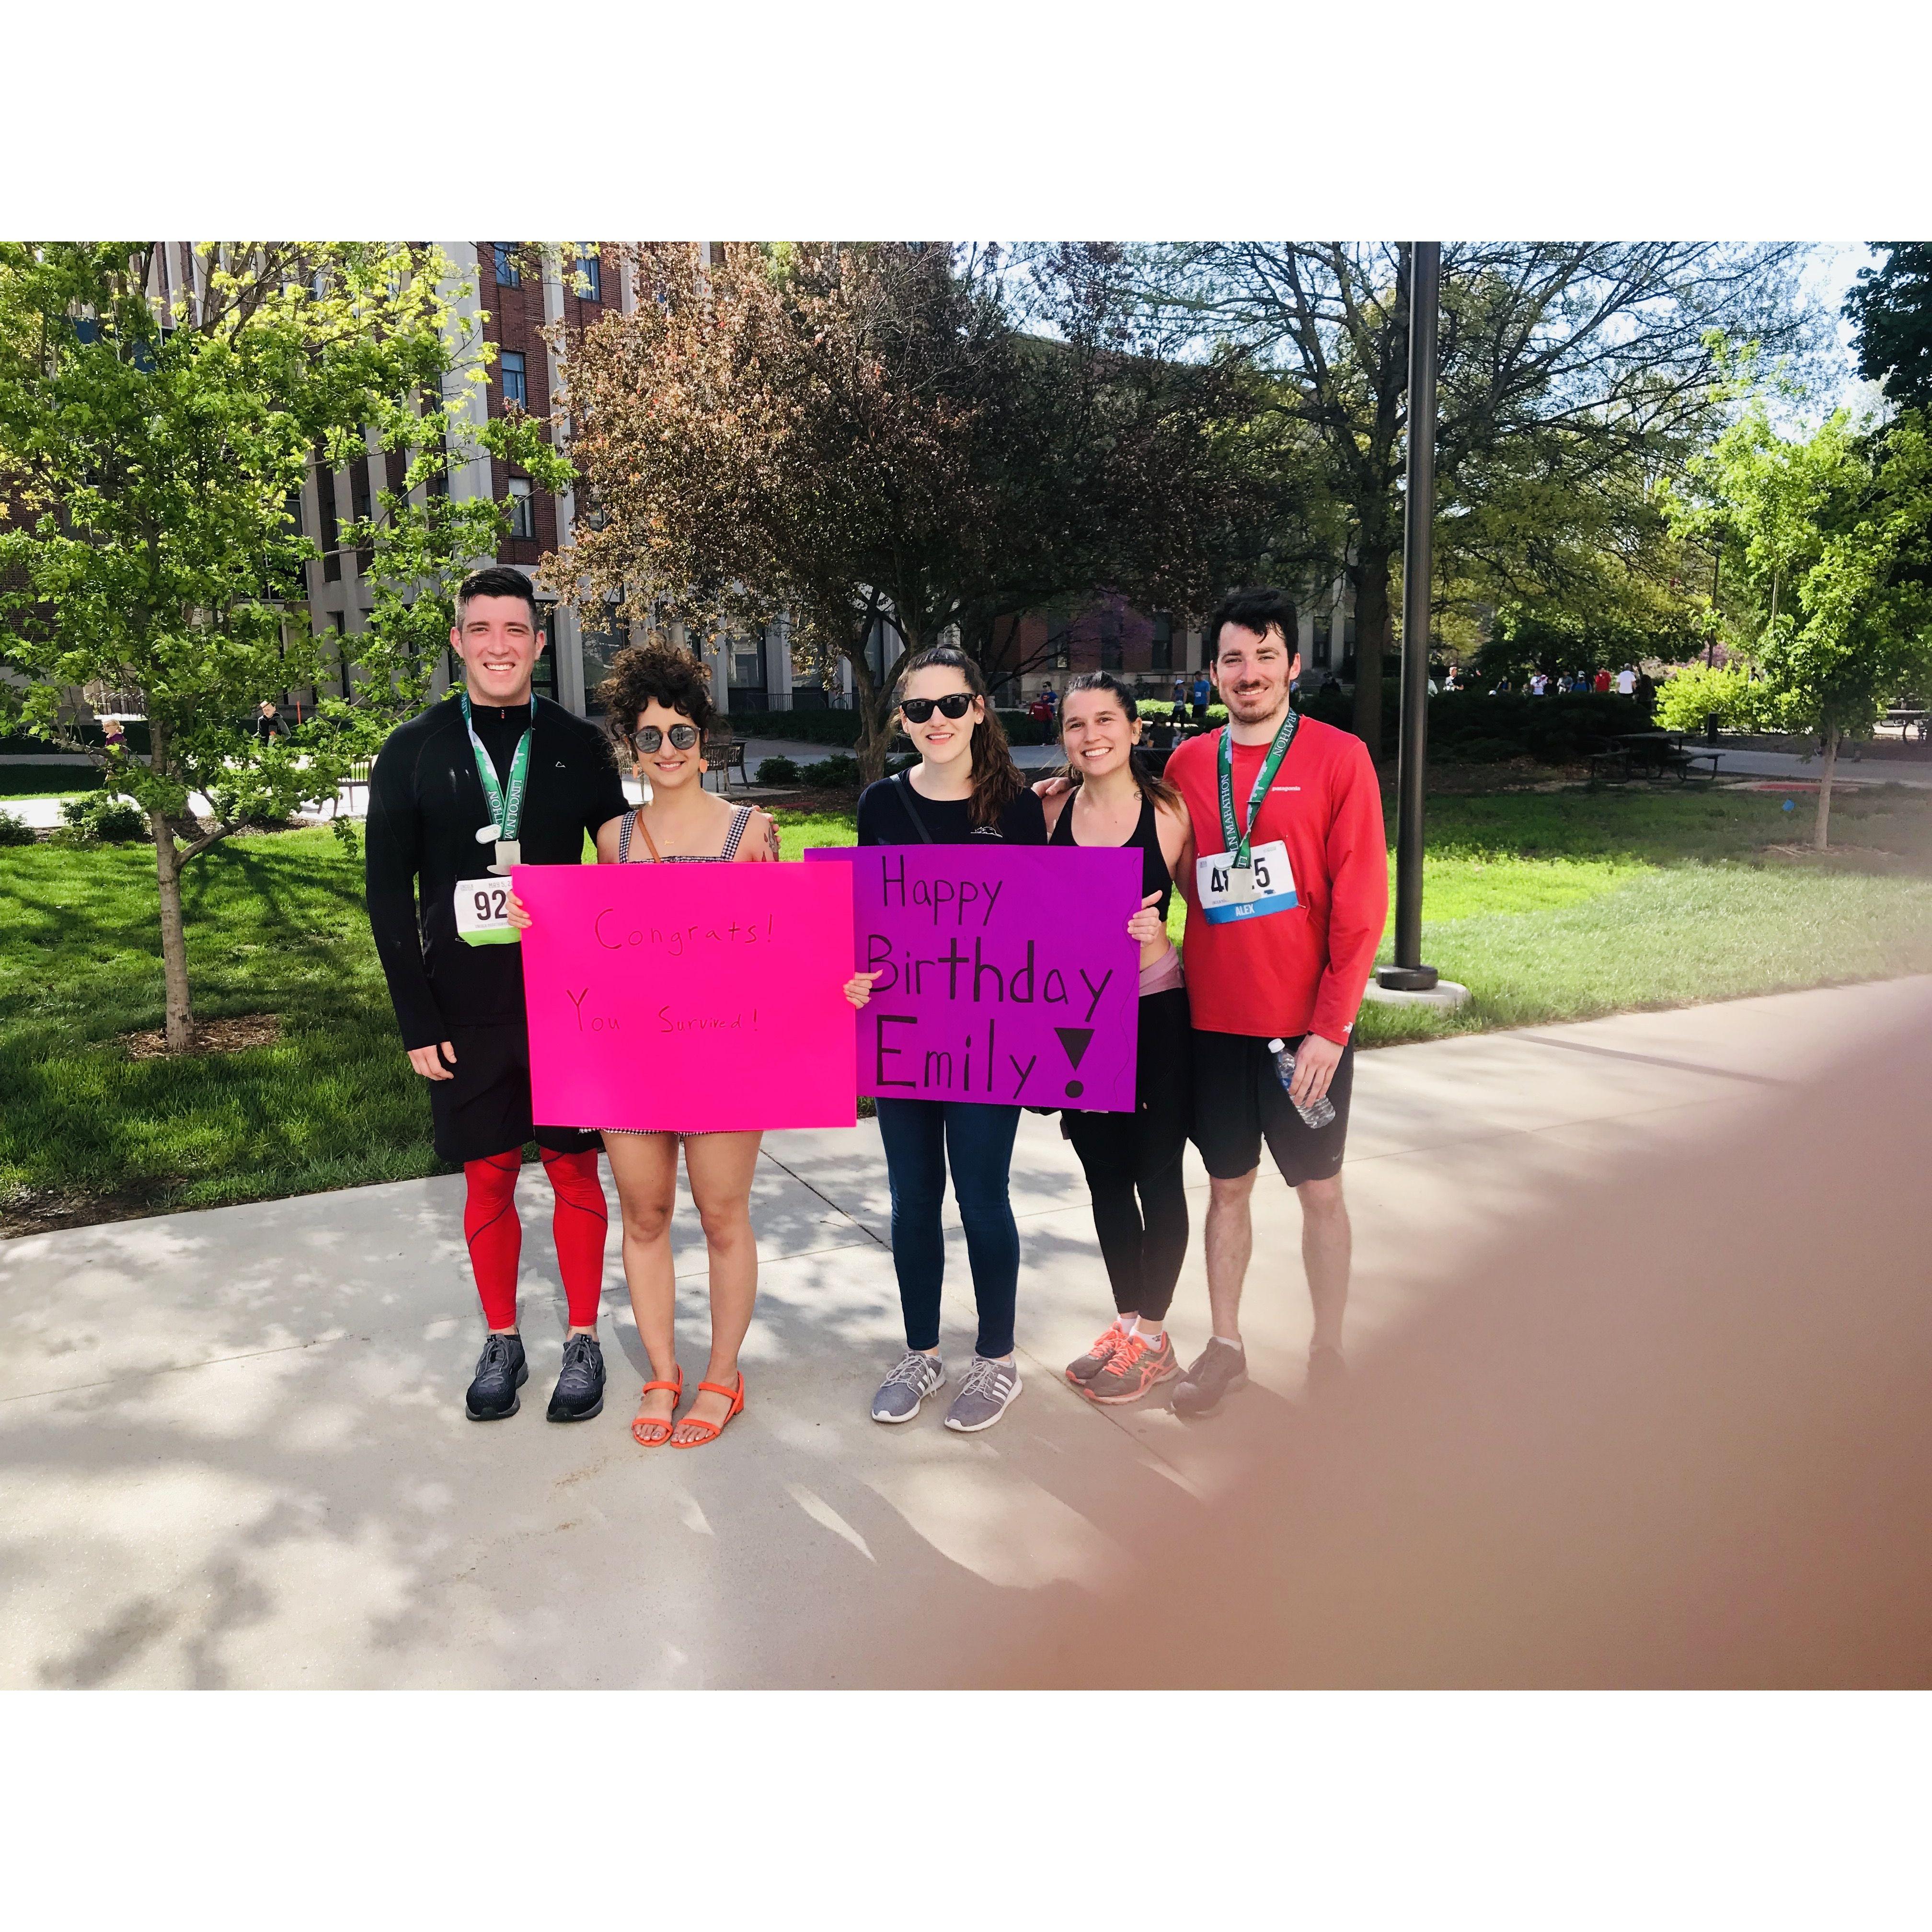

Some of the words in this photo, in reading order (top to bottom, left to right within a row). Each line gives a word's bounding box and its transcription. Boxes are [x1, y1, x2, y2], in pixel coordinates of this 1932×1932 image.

[506, 779, 522, 828] LINCOLN
[1221, 774, 1235, 835] MARATHON
[474, 889, 511, 920] 92
[882, 854, 1002, 926] Happy
[1235, 904, 1255, 916] ALEX
[595, 908, 773, 956] Congrats!
[868, 934, 1113, 1022] Birthday
[566, 988, 621, 1032] You
